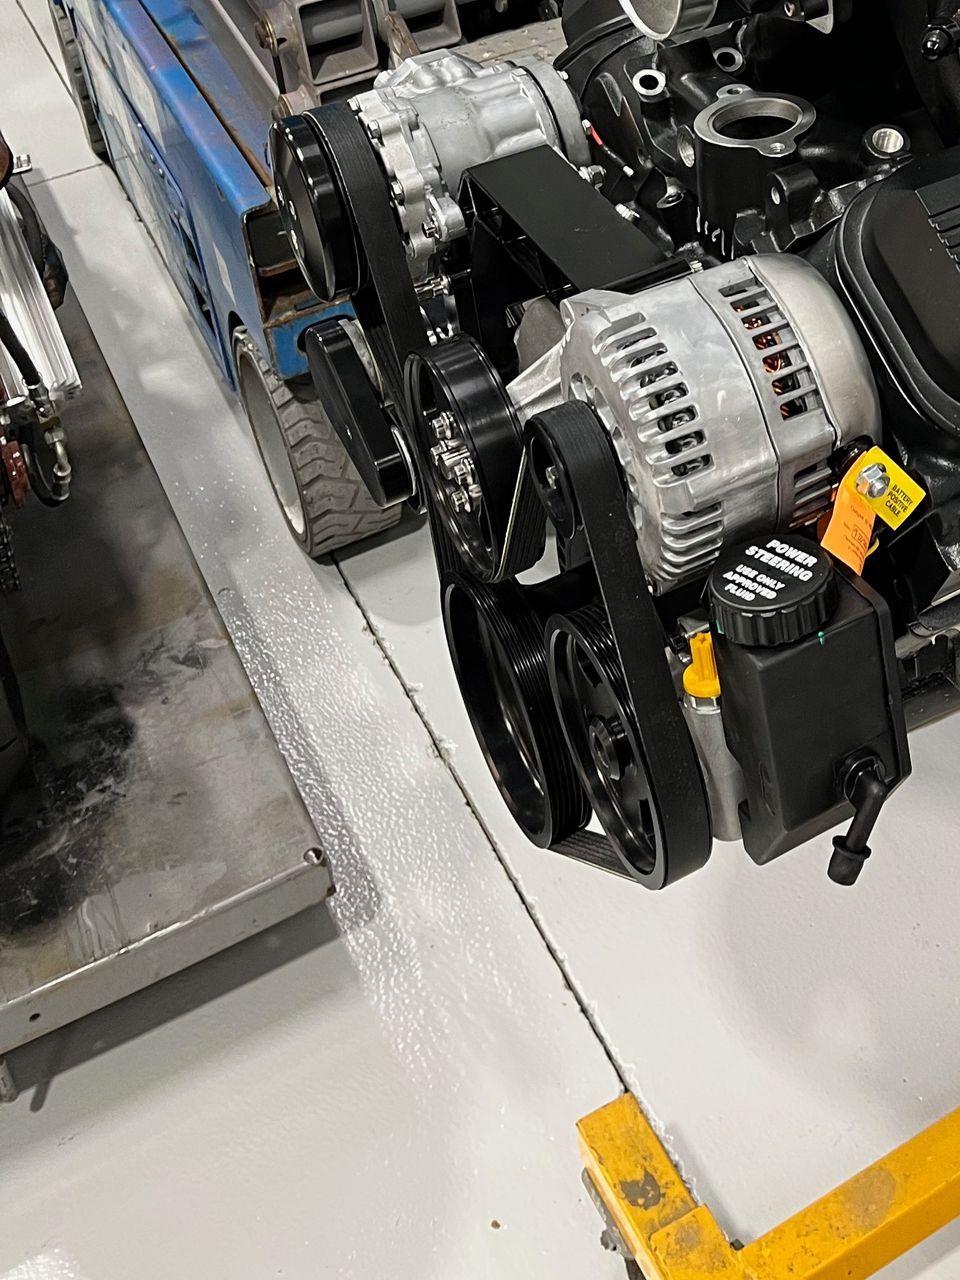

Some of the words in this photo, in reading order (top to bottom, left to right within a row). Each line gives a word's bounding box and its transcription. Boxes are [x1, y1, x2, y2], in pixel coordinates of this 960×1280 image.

[887, 491, 908, 513] POSITIVE
[892, 484, 914, 505] BATTERY
[885, 500, 901, 517] CABLE
[745, 546, 813, 582] STEERING
[766, 539, 818, 568] POWER
[722, 571, 778, 600] APPROVED
[735, 564, 757, 580] USE
[756, 572, 786, 590] ONLY
[724, 583, 756, 601] FLUID
